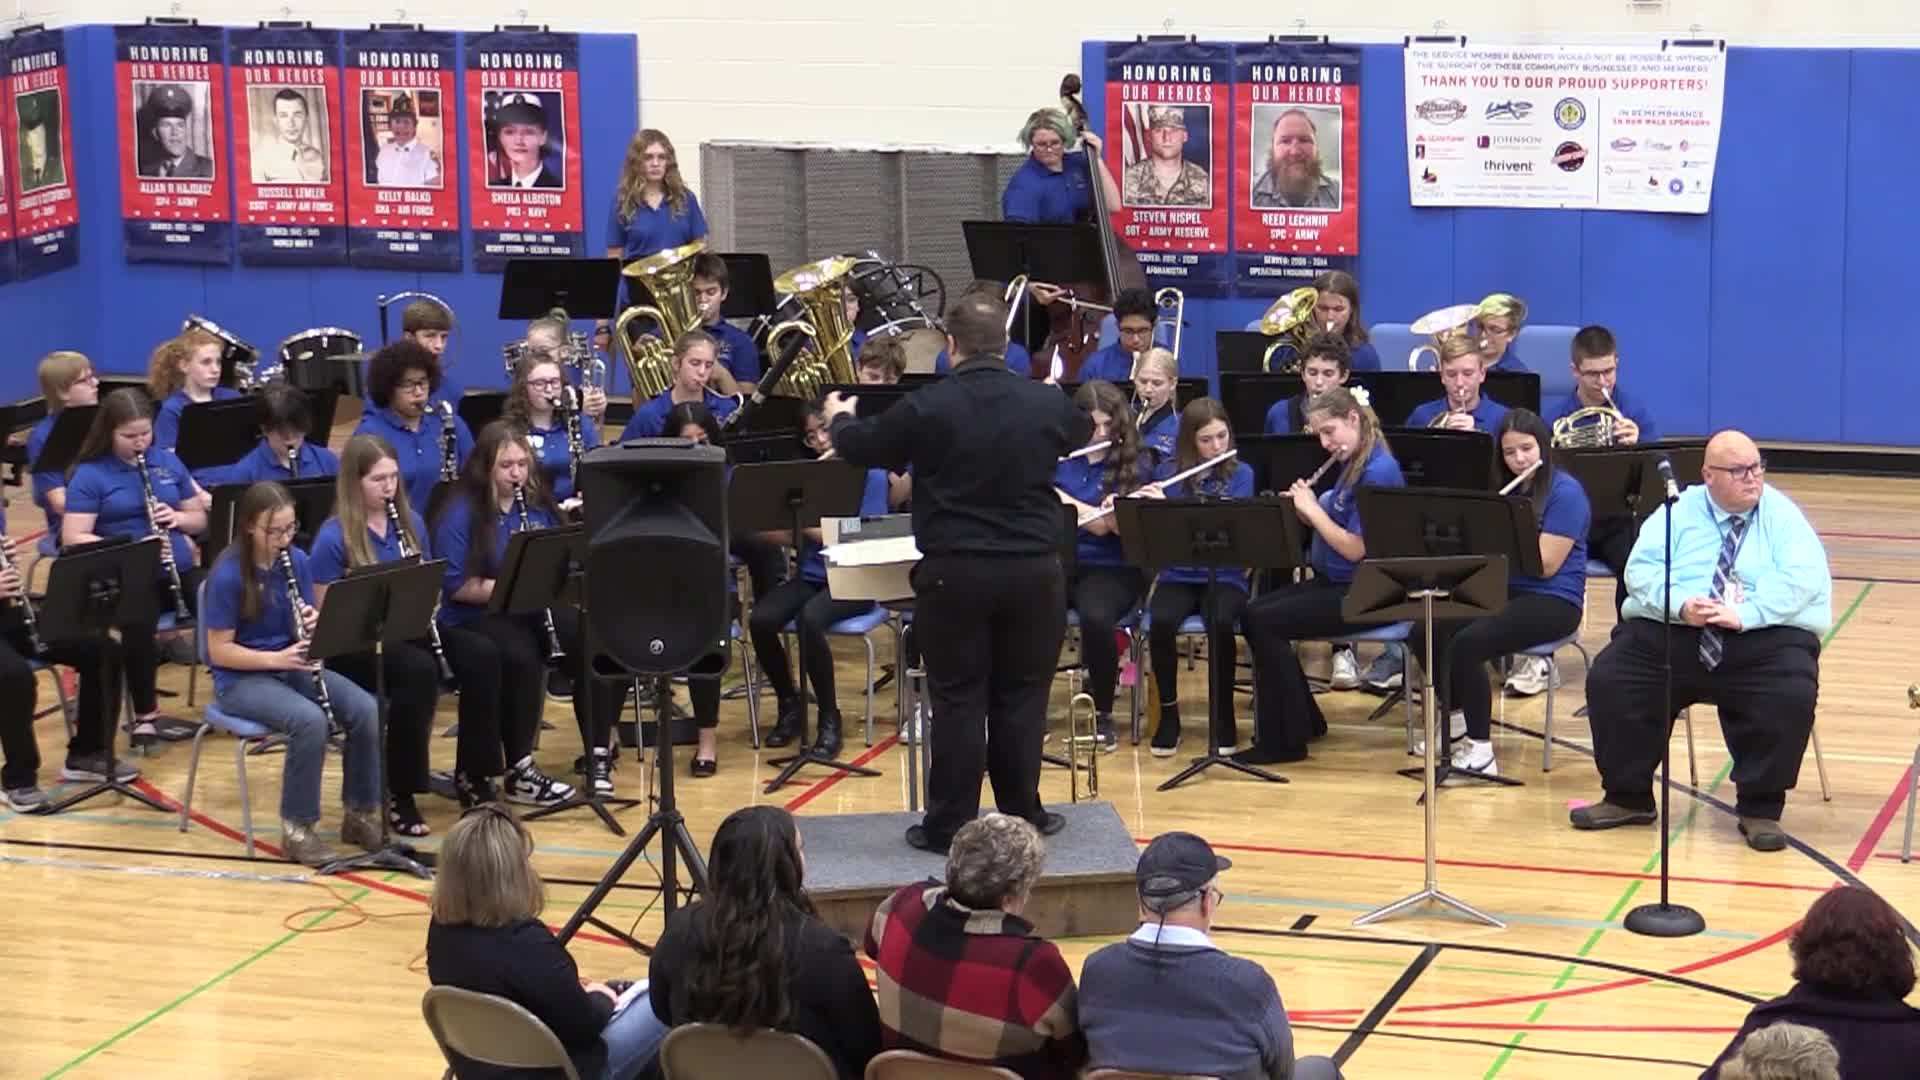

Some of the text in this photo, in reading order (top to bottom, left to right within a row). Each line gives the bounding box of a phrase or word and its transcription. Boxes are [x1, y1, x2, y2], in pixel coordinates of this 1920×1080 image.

[128, 46, 209, 62] HONORING
[244, 50, 324, 65] HONORING
[359, 51, 440, 69] HONORING
[1471, 52, 1509, 60] MEMBER
[479, 53, 563, 70] HONORING
[1495, 63, 1523, 71] THESE
[1525, 63, 1579, 71] COMMUNITY
[1582, 64, 1638, 73] BUSINESSES
[132, 64, 210, 81] OUR HEROES
[245, 68, 325, 84] OUR HEROES
[360, 70, 441, 87] OUR HEROES
[1122, 65, 1212, 83] HONORING
[1251, 65, 1342, 83] HONORING
[482, 71, 563, 89] OUR HEROES
[1422, 74, 1709, 91] THANK YOU TO OUR PROUD SUPPORTERS!
[1122, 84, 1212, 102] OUR HEROES
[1252, 84, 1342, 103] OUR HEROES
[1493, 135, 1542, 145] JOHNSON
[1484, 159, 1534, 173] thrivent
[258, 187, 326, 199] RUSSELL LEMLER
[378, 191, 431, 203] KELLY BALKO
[491, 192, 520, 205] SHEILA
[528, 208, 547, 218] NAVY
[1132, 211, 1203, 225] STEVEN NISPEL
[1262, 213, 1329, 228] REED LECHNIR
[1149, 227, 1173, 237] ARMY
[1174, 227, 1210, 239] RESERVE
[1270, 229, 1287, 241] SPC
[1295, 229, 1320, 241] ARMY
[1264, 255, 1290, 265] SERVED:
[1146, 265, 1189, 277] AFGHANISTAN
[1249, 267, 1282, 277] OPERATION
